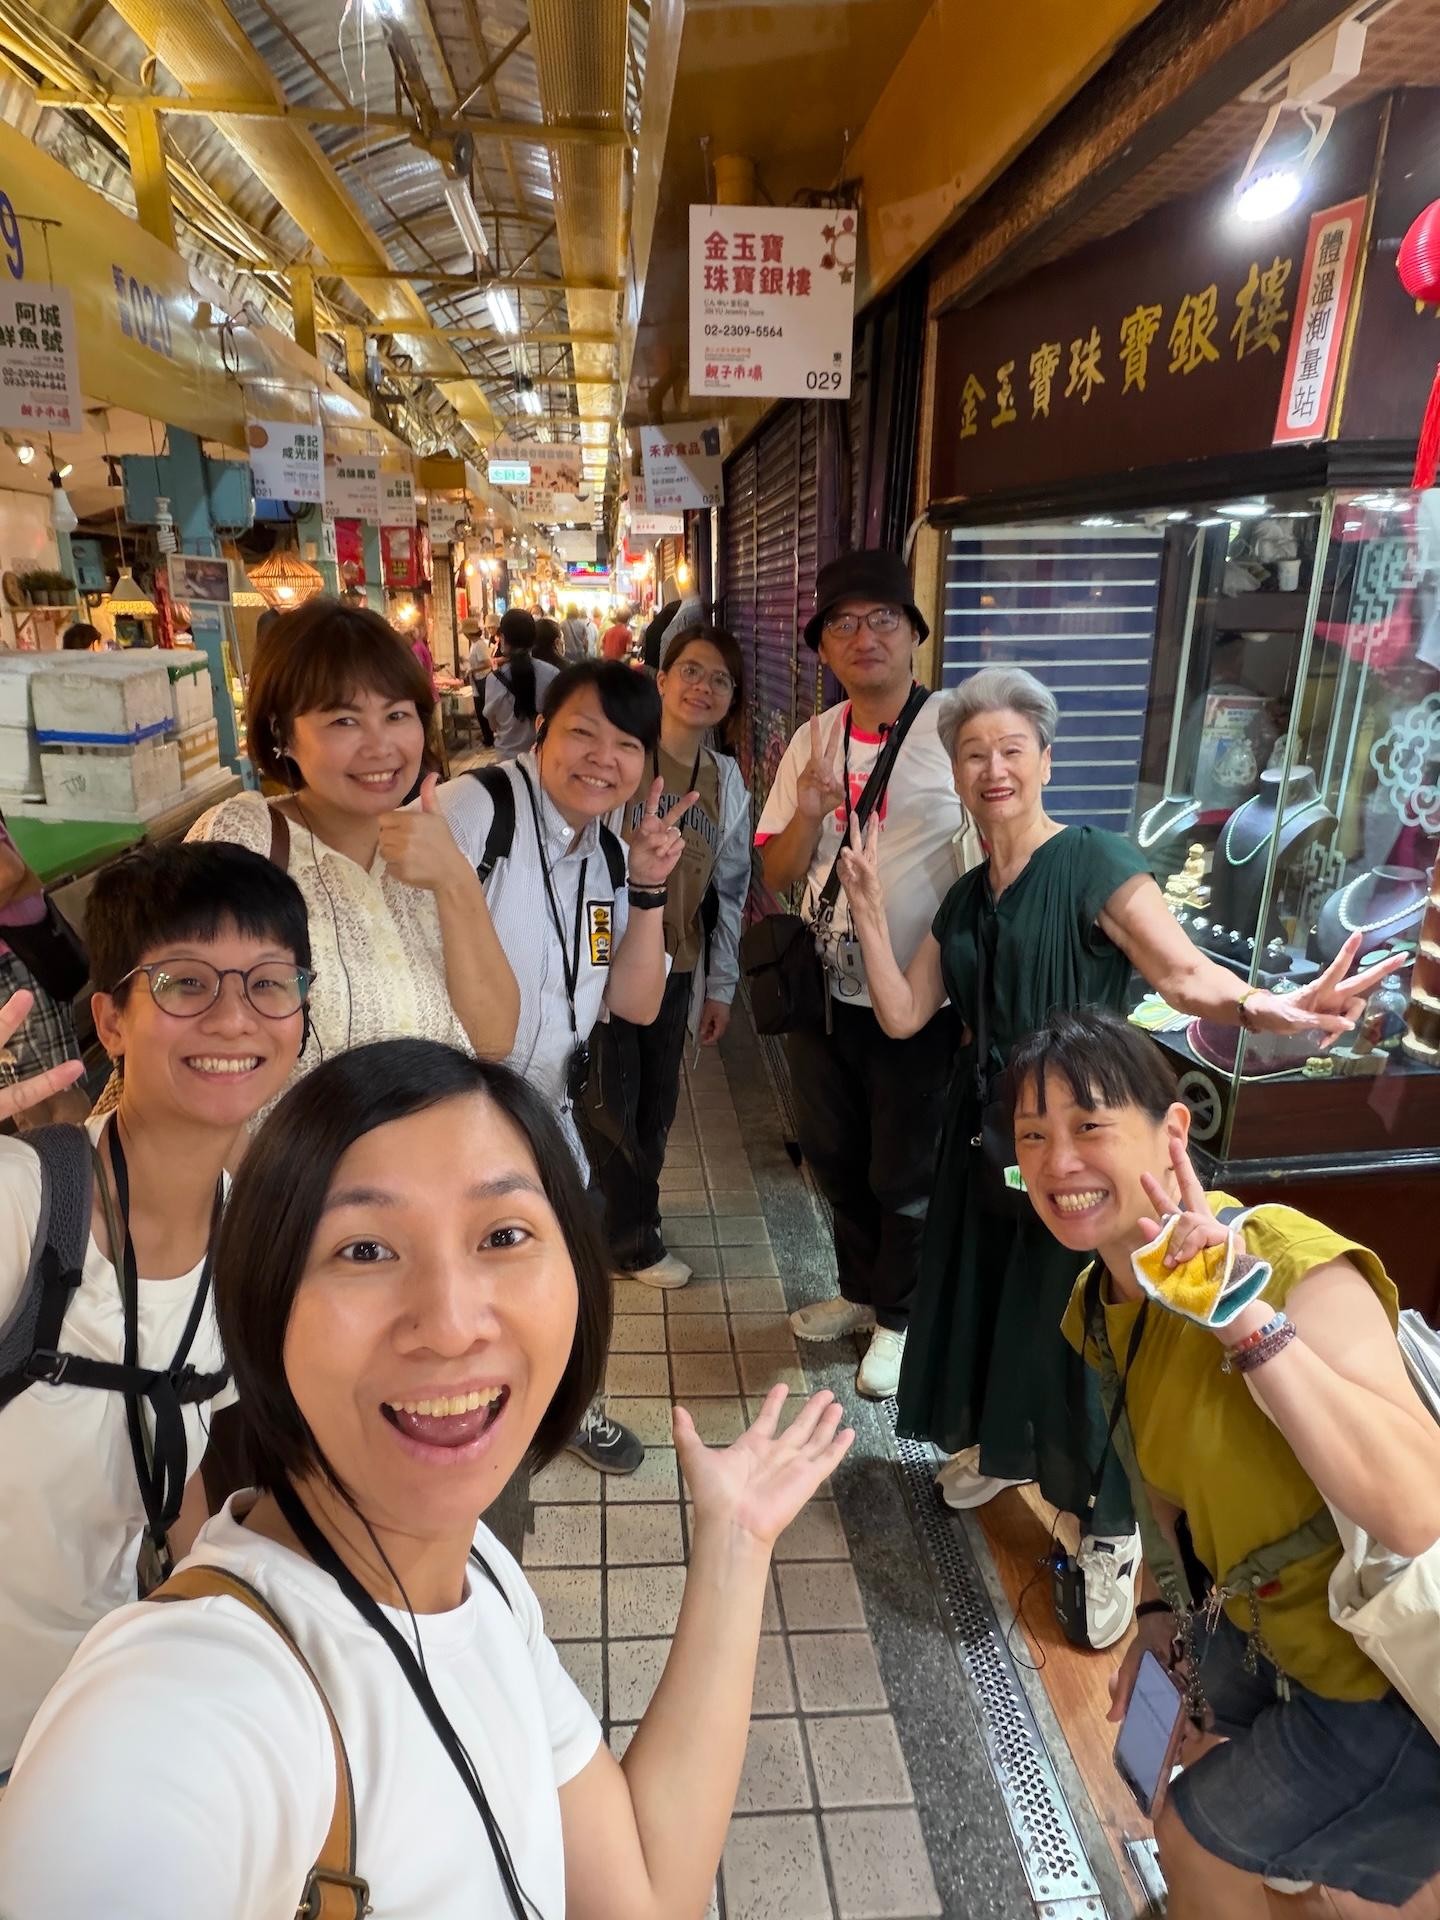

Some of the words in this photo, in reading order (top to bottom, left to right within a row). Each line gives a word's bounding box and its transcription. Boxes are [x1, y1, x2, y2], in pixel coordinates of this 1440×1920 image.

[704, 230, 785, 264] 金玉寶
[703, 265, 812, 297] 珠寶銀樓
[15, 301, 61, 328] 阿城
[1291, 230, 1344, 418] 體溫測量站
[704, 324, 783, 338] 02-2309-5564
[959, 255, 1293, 440] 金玉寶珠寶銀樓
[806, 371, 842, 391] 029
